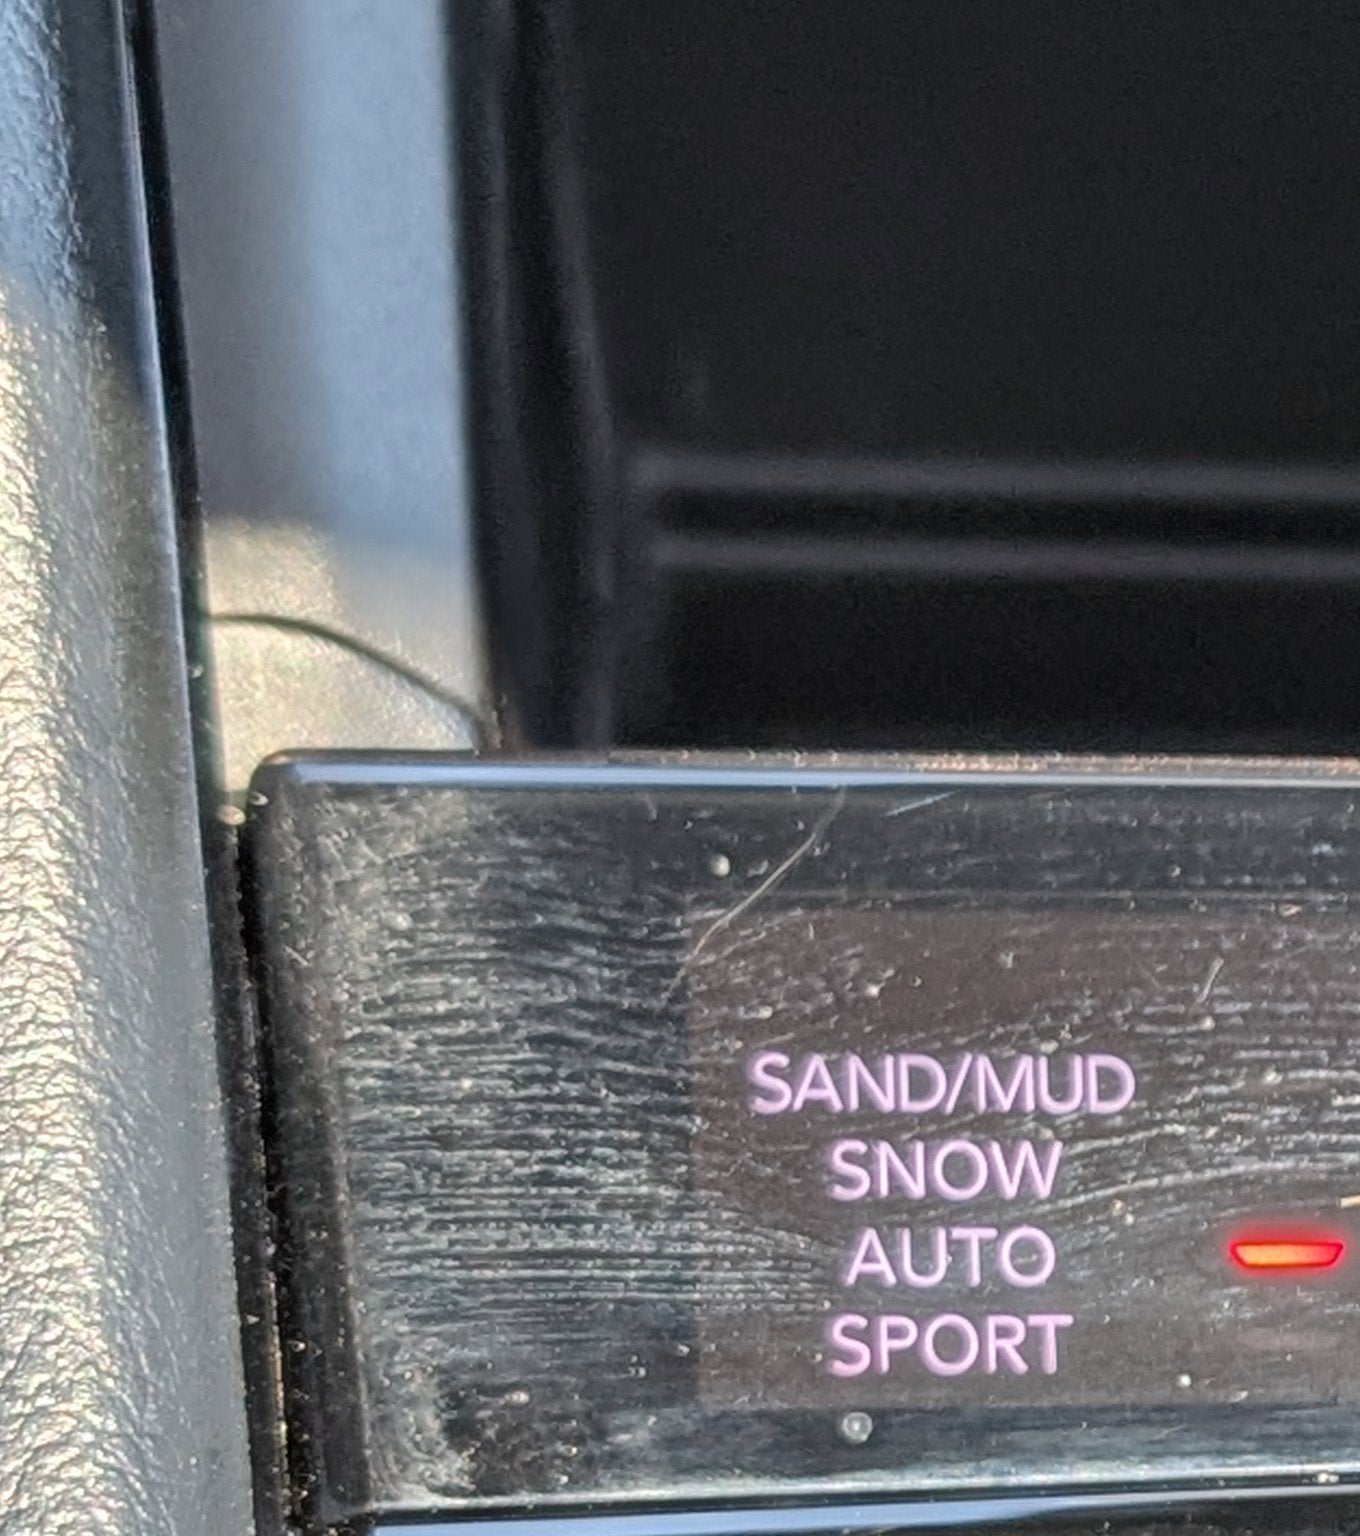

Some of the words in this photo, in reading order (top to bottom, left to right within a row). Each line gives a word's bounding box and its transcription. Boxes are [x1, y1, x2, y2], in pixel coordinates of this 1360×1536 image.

[747, 1051, 1138, 1116] SAND/MUD
[829, 1138, 1064, 1201] SNOW
[844, 1226, 1057, 1289] AUTO
[826, 1312, 1075, 1376] SPORT
